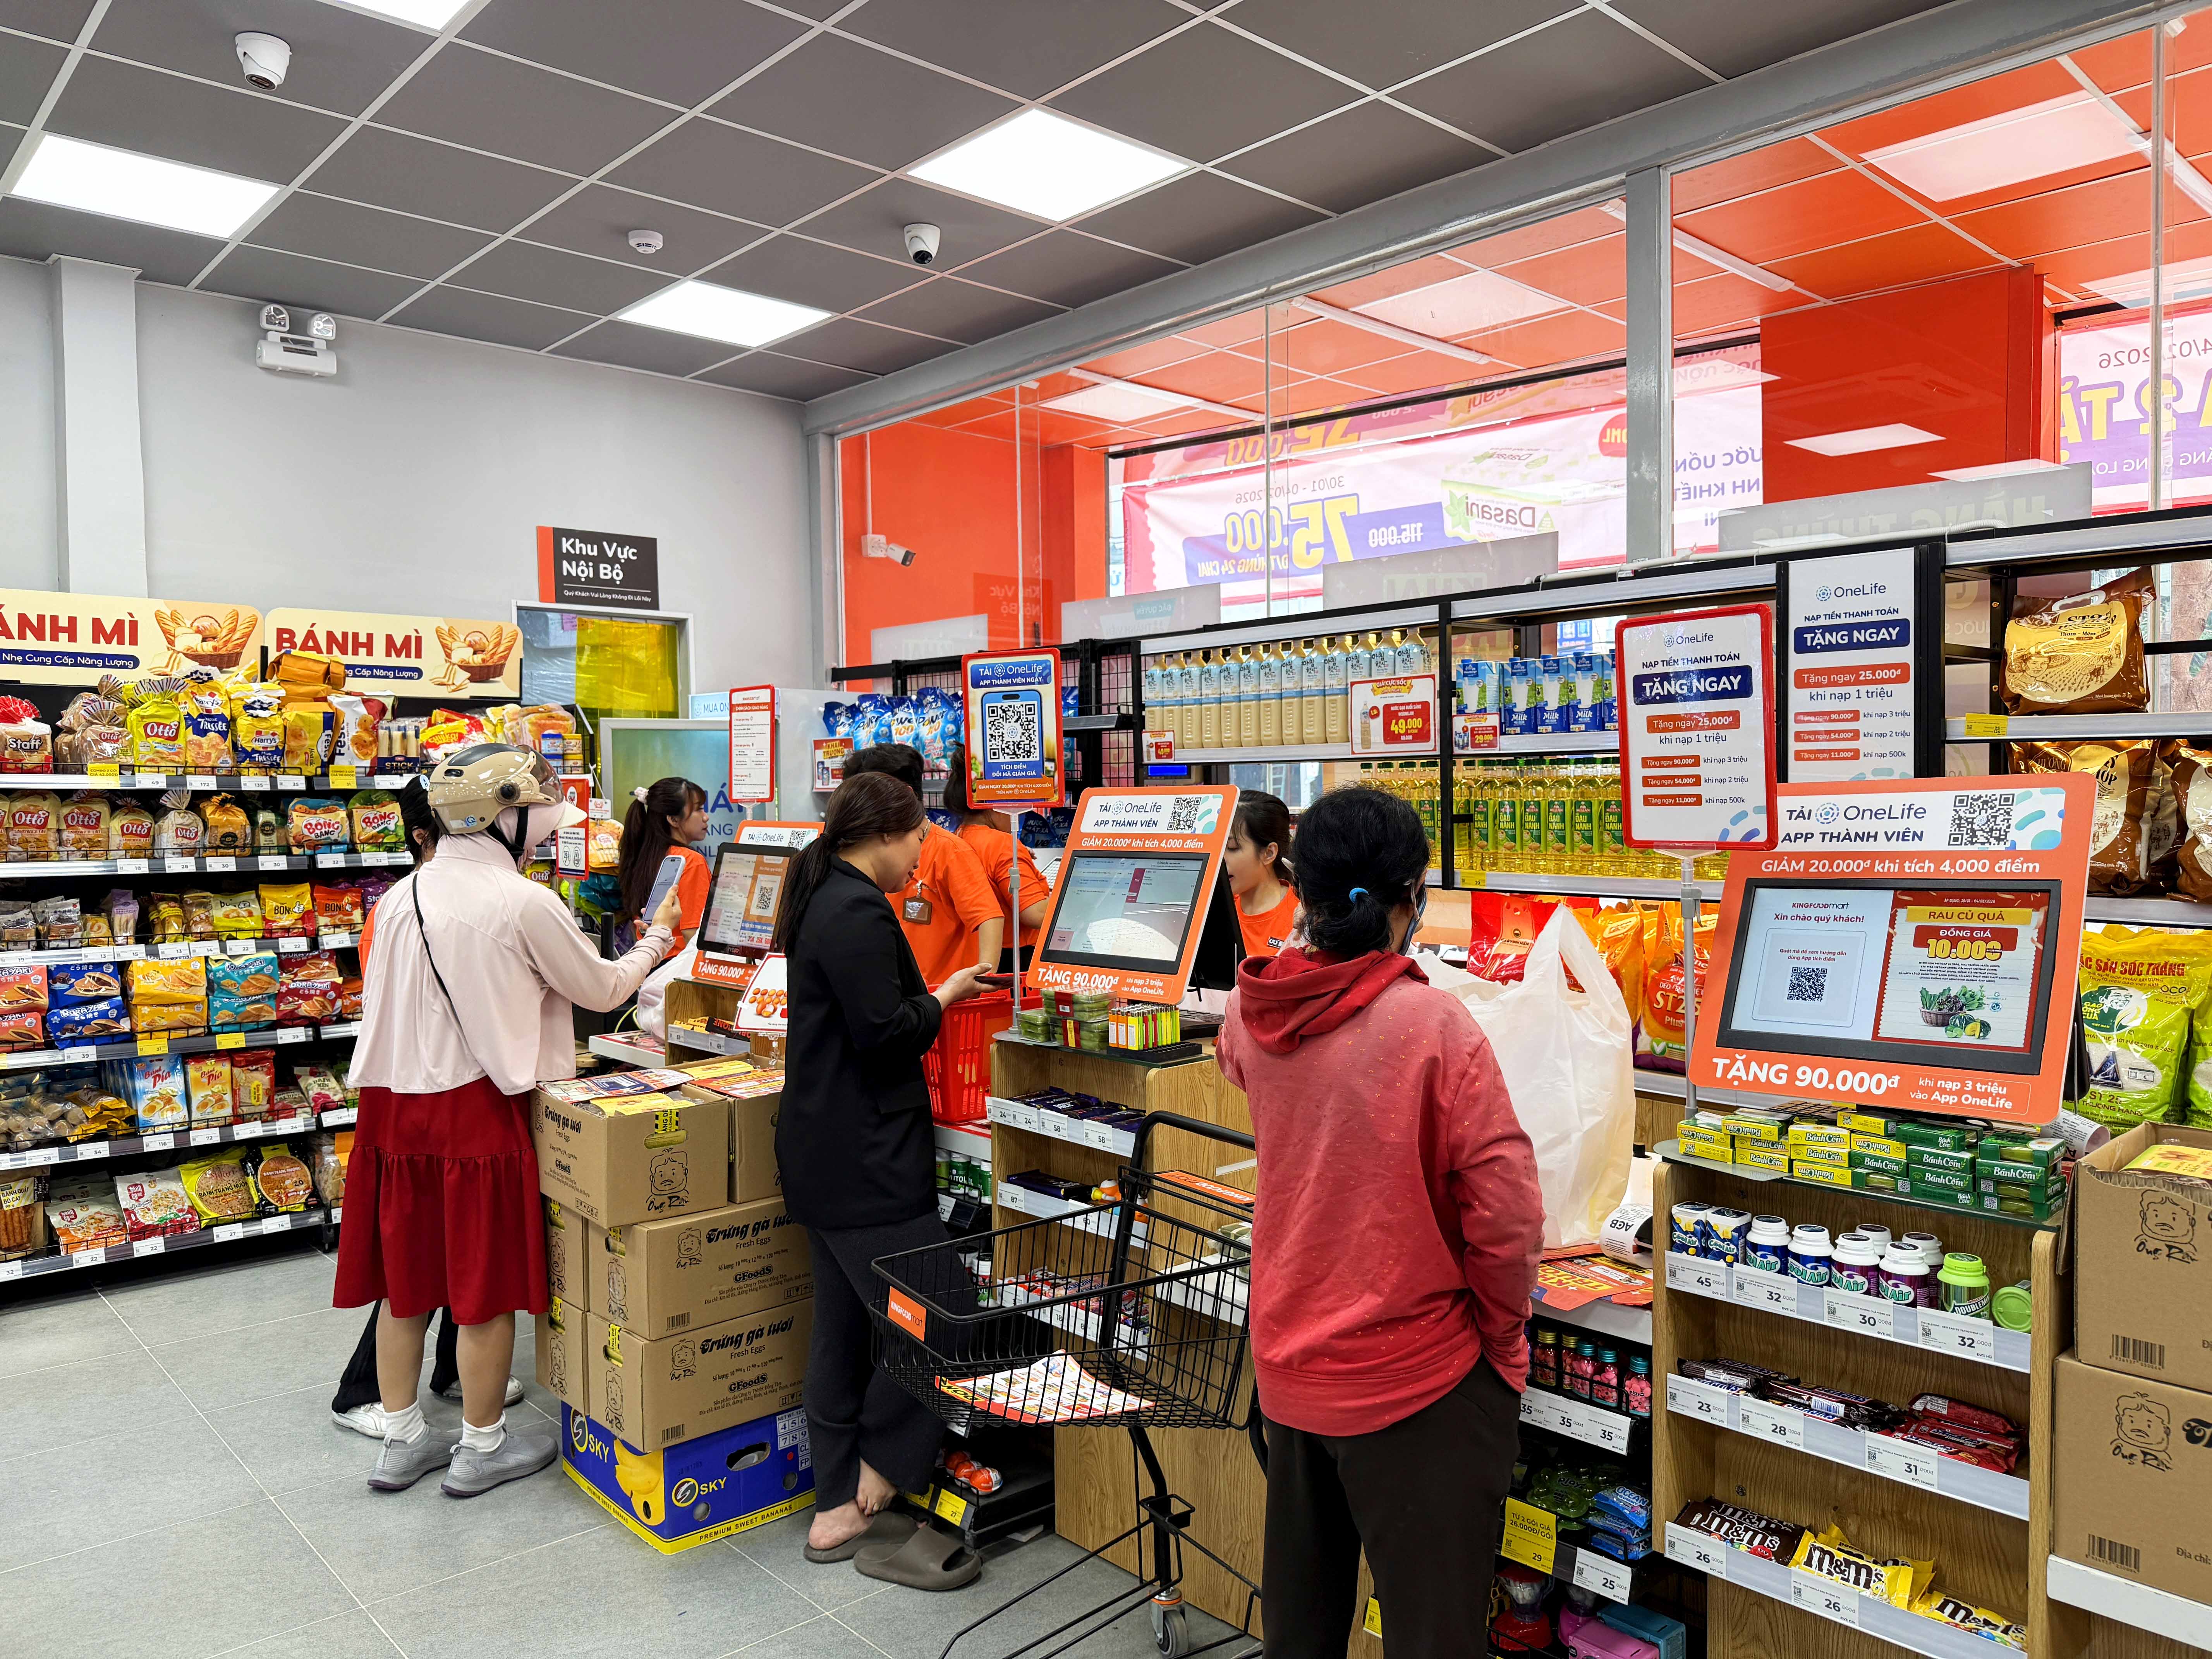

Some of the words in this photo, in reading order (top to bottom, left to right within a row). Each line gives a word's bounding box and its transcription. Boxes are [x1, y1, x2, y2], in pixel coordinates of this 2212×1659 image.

[562, 538, 598, 556] Khu
[603, 541, 637, 562] Vực
[562, 561, 593, 582] Nội
[599, 563, 623, 584] Bộ
[1834, 583, 1886, 598] OneLife
[92, 613, 138, 646] MÌ
[276, 623, 374, 656] BÁNH
[385, 629, 422, 659] MÌ
[1676, 632, 1713, 644] OneLife
[1803, 629, 1848, 649] TẶNG
[1853, 627, 1899, 642] NGAY
[2, 653, 22, 663] Nhẹ
[26, 654, 52, 665] Cung
[55, 654, 74, 666] Cấp
[77, 655, 102, 666] Năng
[105, 657, 133, 668] Lượng
[1642, 661, 1659, 670] NẠP
[1661, 655, 1679, 667] TIỀN
[1682, 654, 1712, 666] THANH
[1715, 652, 1740, 662] TOÁN
[979, 666, 992, 675] TẢI
[1007, 665, 1042, 674] OneLife
[1643, 678, 1687, 699] TẶNG
[1693, 675, 1741, 692] NGAY
[1544, 712, 1559, 721] Milk
[1653, 718, 1673, 730] Tặng
[1675, 719, 1695, 729] ngay
[147, 723, 177, 738] Otto
[1391, 718, 1422, 734] 49.000
[9, 738, 41, 750] Staff
[1099, 803, 1111, 812] TẢI
[1125, 803, 1161, 813] OneLife
[1786, 805, 1811, 820] TẢI
[1843, 802, 1926, 820] OneLife
[15, 812, 43, 826] Otto
[1111, 817, 1137, 827] THÀNH
[1140, 817, 1158, 827] VIÊN
[1782, 832, 1814, 843] APP
[1819, 827, 1877, 843] THÀNH
[1884, 828, 1923, 842] VIÊN
[1762, 857, 1805, 873] GIẢM
[1874, 859, 1899, 872] khi
[1903, 859, 1934, 873] tích
[1939, 859, 1989, 874] 4,000
[1994, 858, 2039, 873] điểm
[532, 871, 548, 881] Otto
[1814, 914, 1831, 923] quý
[1929, 911, 1953, 920] RAU
[1957, 910, 1974, 920] CỦ
[1978, 910, 2004, 921] QUẢ
[1940, 927, 1970, 937] ĐỒNG
[1973, 929, 1991, 937] GIÁ
[1038, 966, 1071, 986] TẶNG
[1712, 1053, 1788, 1085] TẶNG
[1795, 1065, 1899, 1096] 90.000đ
[1919, 1077, 1935, 1087] khi
[1937, 1079, 1961, 1091] nạp
[1964, 1080, 1972, 1091] 3
[1976, 1081, 2006, 1095] triệu
[1910, 1089, 1928, 1100] vào
[1931, 1091, 1957, 1105] App
[1962, 1093, 2012, 1110] OneLife
[746, 1324, 765, 1346] gà
[730, 1349, 748, 1359] Fresh
[751, 1345, 765, 1354] Eggs
[589, 1434, 609, 1463] SKY
[700, 1478, 726, 1494] SKY
[699, 1527, 732, 1541] PREMIUM
[735, 1517, 758, 1530] SWEET
[761, 1505, 792, 1522] BANANAS
[1528, 1517, 1538, 1528] GÓI
[1540, 1523, 1551, 1531] GIÁ
[2176, 1547, 2191, 1559] Địa
